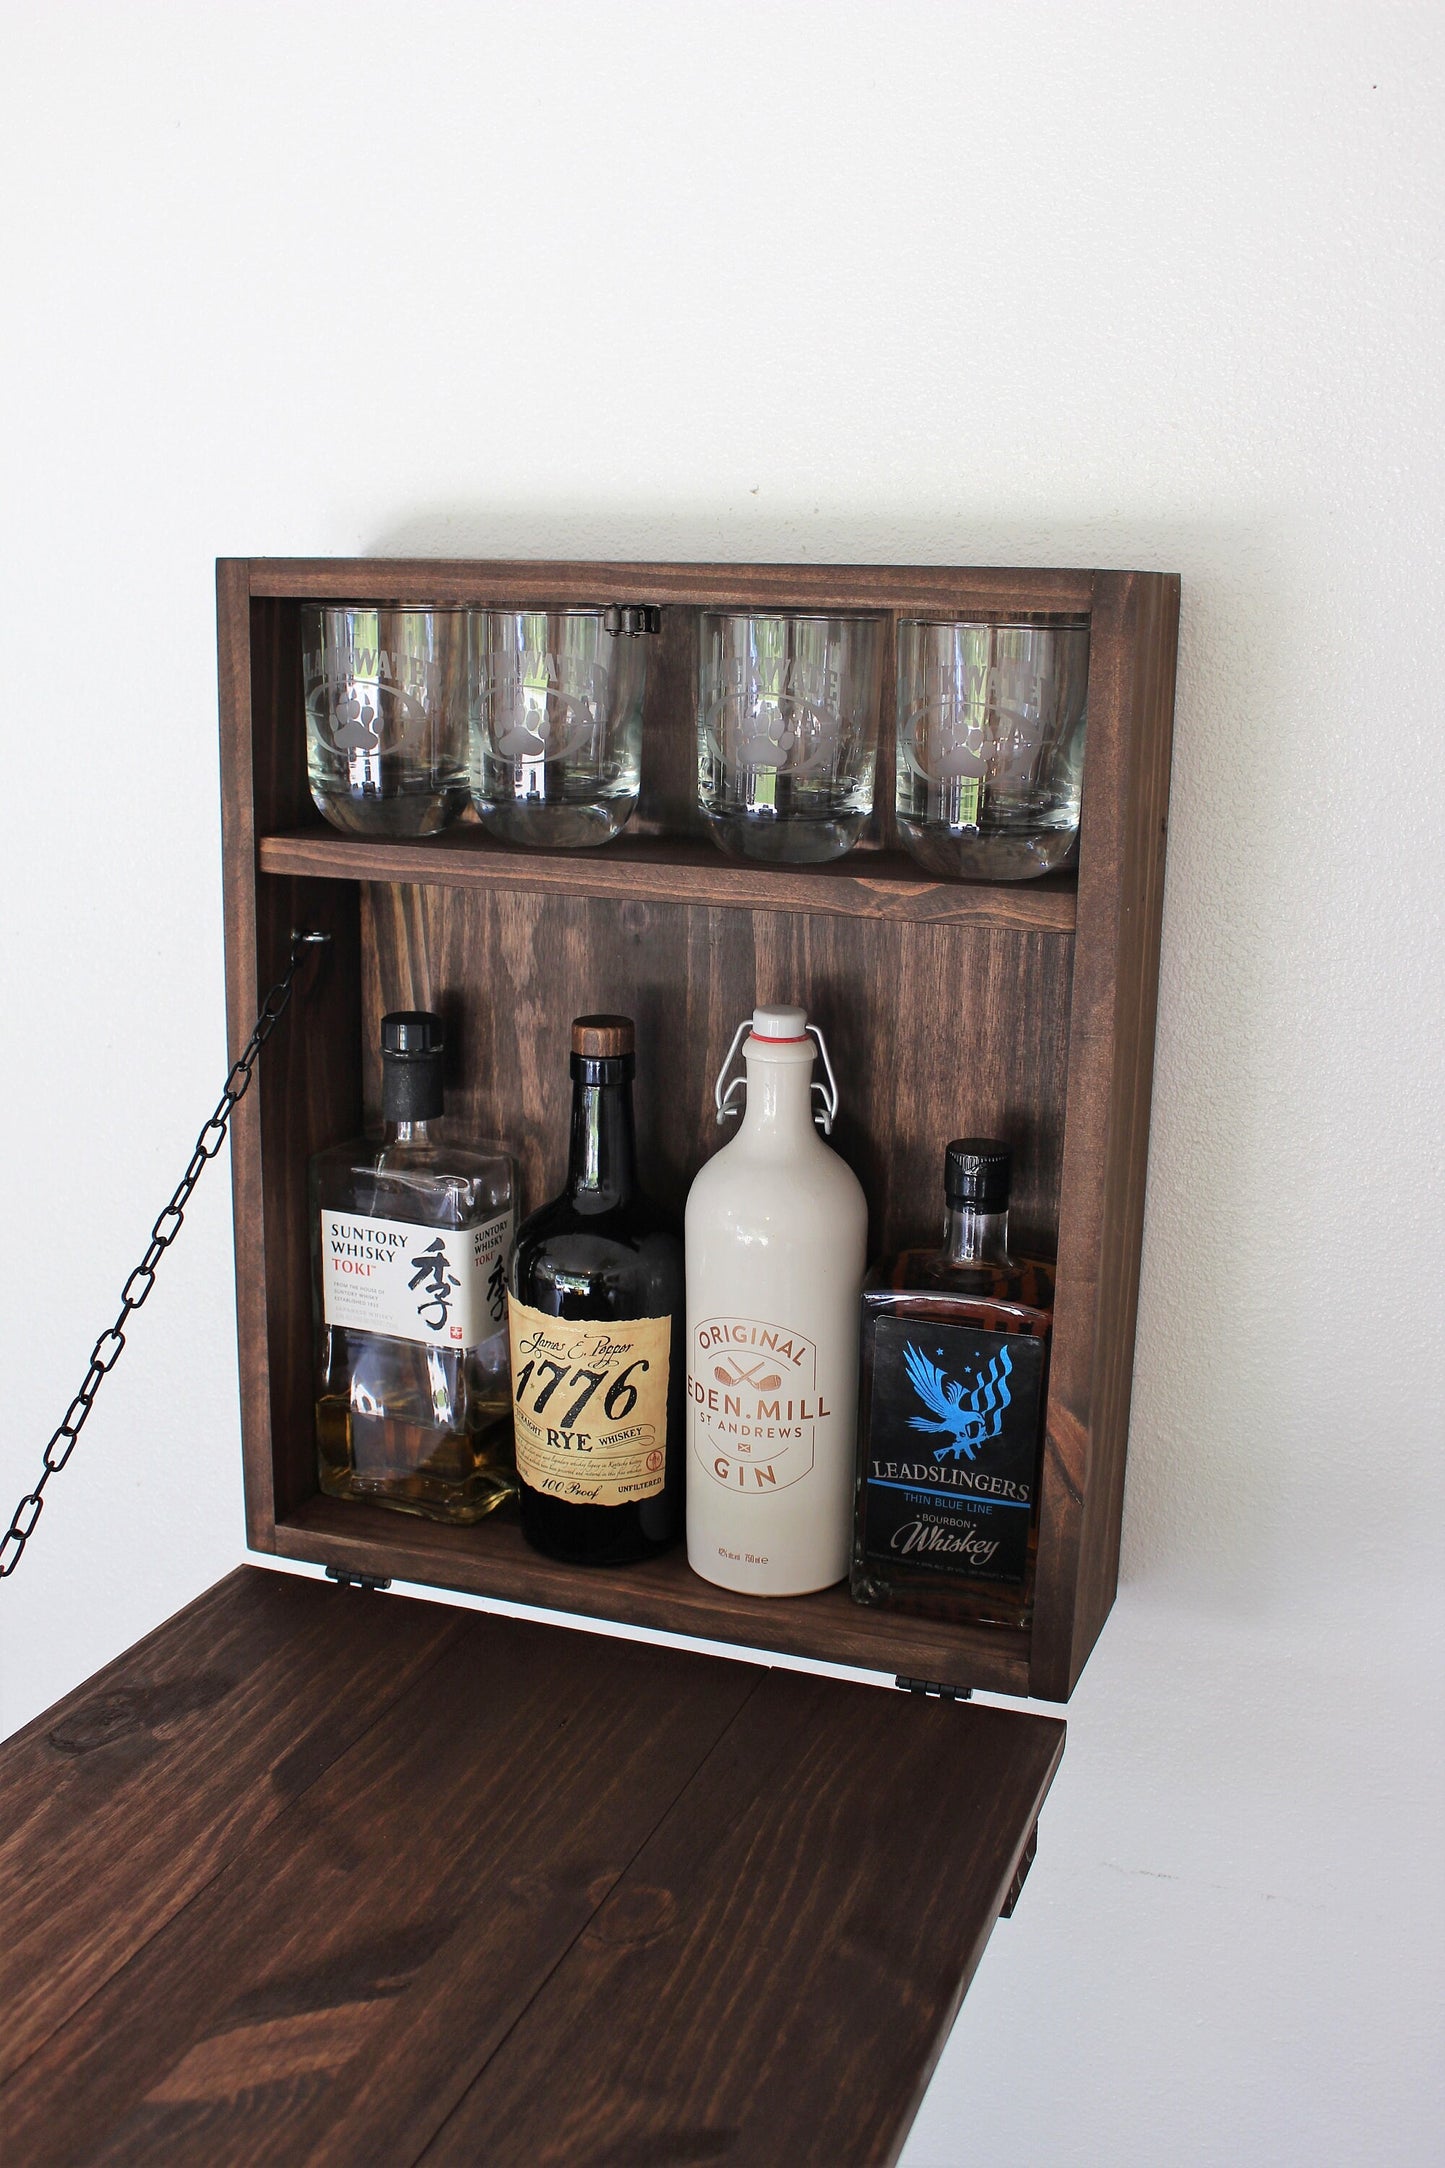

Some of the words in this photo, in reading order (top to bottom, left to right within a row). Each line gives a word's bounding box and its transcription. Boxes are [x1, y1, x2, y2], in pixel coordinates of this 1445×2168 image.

[331, 1224, 408, 1247] SUNTORY
[475, 1221, 507, 1243] SUNTORY
[331, 1240, 395, 1262] WHISKY
[475, 1234, 503, 1254] WHISKY
[332, 1257, 370, 1276] TOKI
[475, 1252, 493, 1267] TOKI
[408, 1237, 461, 1330] 季
[519, 1332, 565, 1360] James
[567, 1341, 587, 1359] E.
[584, 1333, 634, 1369] Pepper
[699, 1324, 806, 1366] ORIGINAL
[515, 1359, 649, 1428] 1776
[546, 1427, 593, 1452] RYE
[598, 1427, 642, 1446] WHISKEY
[717, 1420, 802, 1438] ANDREWS
[714, 1457, 777, 1487] GIN
[872, 1460, 1030, 1502] LEADSLINGERS
[542, 1478, 564, 1493] 100
[565, 1481, 602, 1499] Proof
[618, 1477, 662, 1493] UNFILTERED
[904, 1492, 931, 1505] THIN
[935, 1497, 963, 1510] BLUE
[967, 1502, 993, 1515] LINE
[922, 1513, 971, 1528] BOURBON
[890, 1521, 1000, 1565] Whiskey
